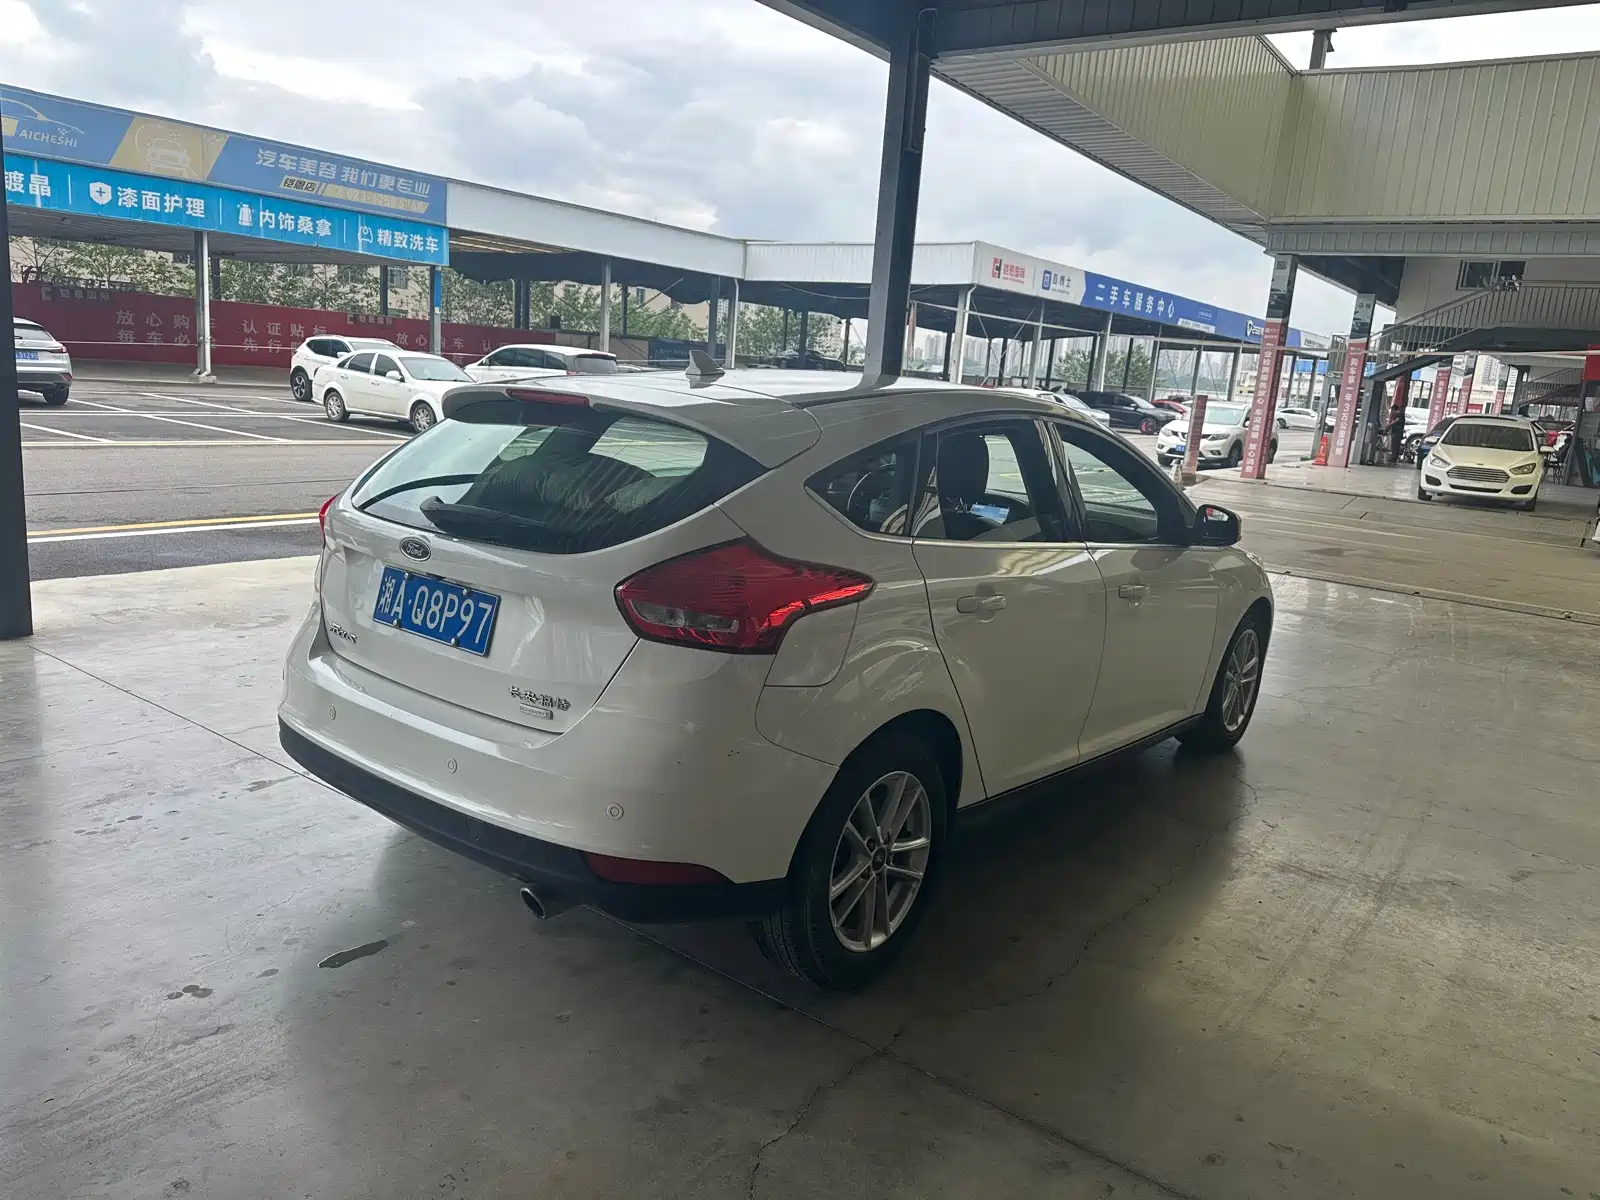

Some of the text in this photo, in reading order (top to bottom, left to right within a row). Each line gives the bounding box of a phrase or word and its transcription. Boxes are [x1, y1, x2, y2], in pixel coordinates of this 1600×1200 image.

[19, 129, 77, 148] AICHESHI
[256, 148, 431, 198] 汽车美容 我们更专业
[282, 176, 317, 193] 铠恩店
[117, 186, 205, 219] 漆面护理
[259, 209, 332, 237] 内饰桑拿
[377, 228, 439, 253] 精致洗车
[1095, 283, 1175, 318] 二手车服务中心
[406, 542, 423, 557] Ford
[508, 685, 571, 711] 长安福特
